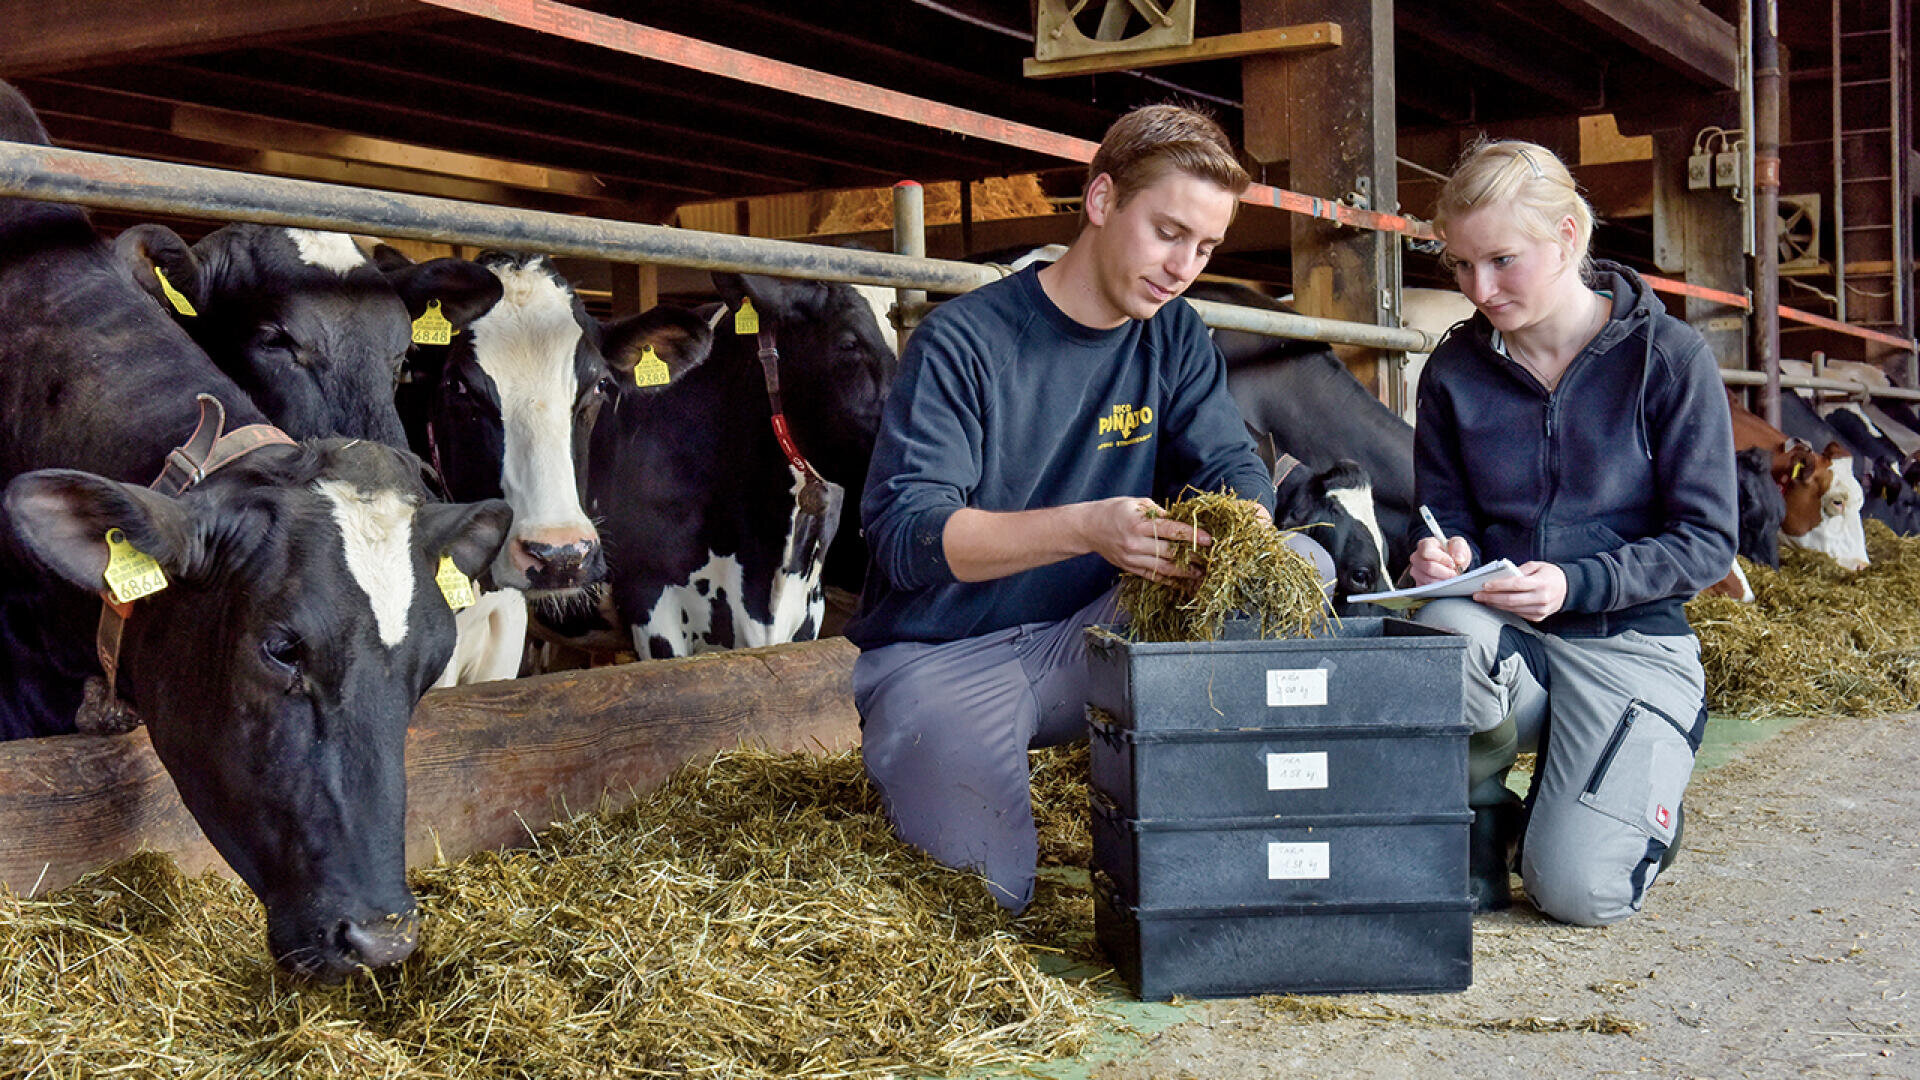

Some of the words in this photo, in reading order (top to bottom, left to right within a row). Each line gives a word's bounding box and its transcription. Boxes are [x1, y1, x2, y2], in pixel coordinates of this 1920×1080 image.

[414, 330, 447, 342] 6848
[121, 571, 163, 599] 6864
[446, 589, 473, 607] 864
